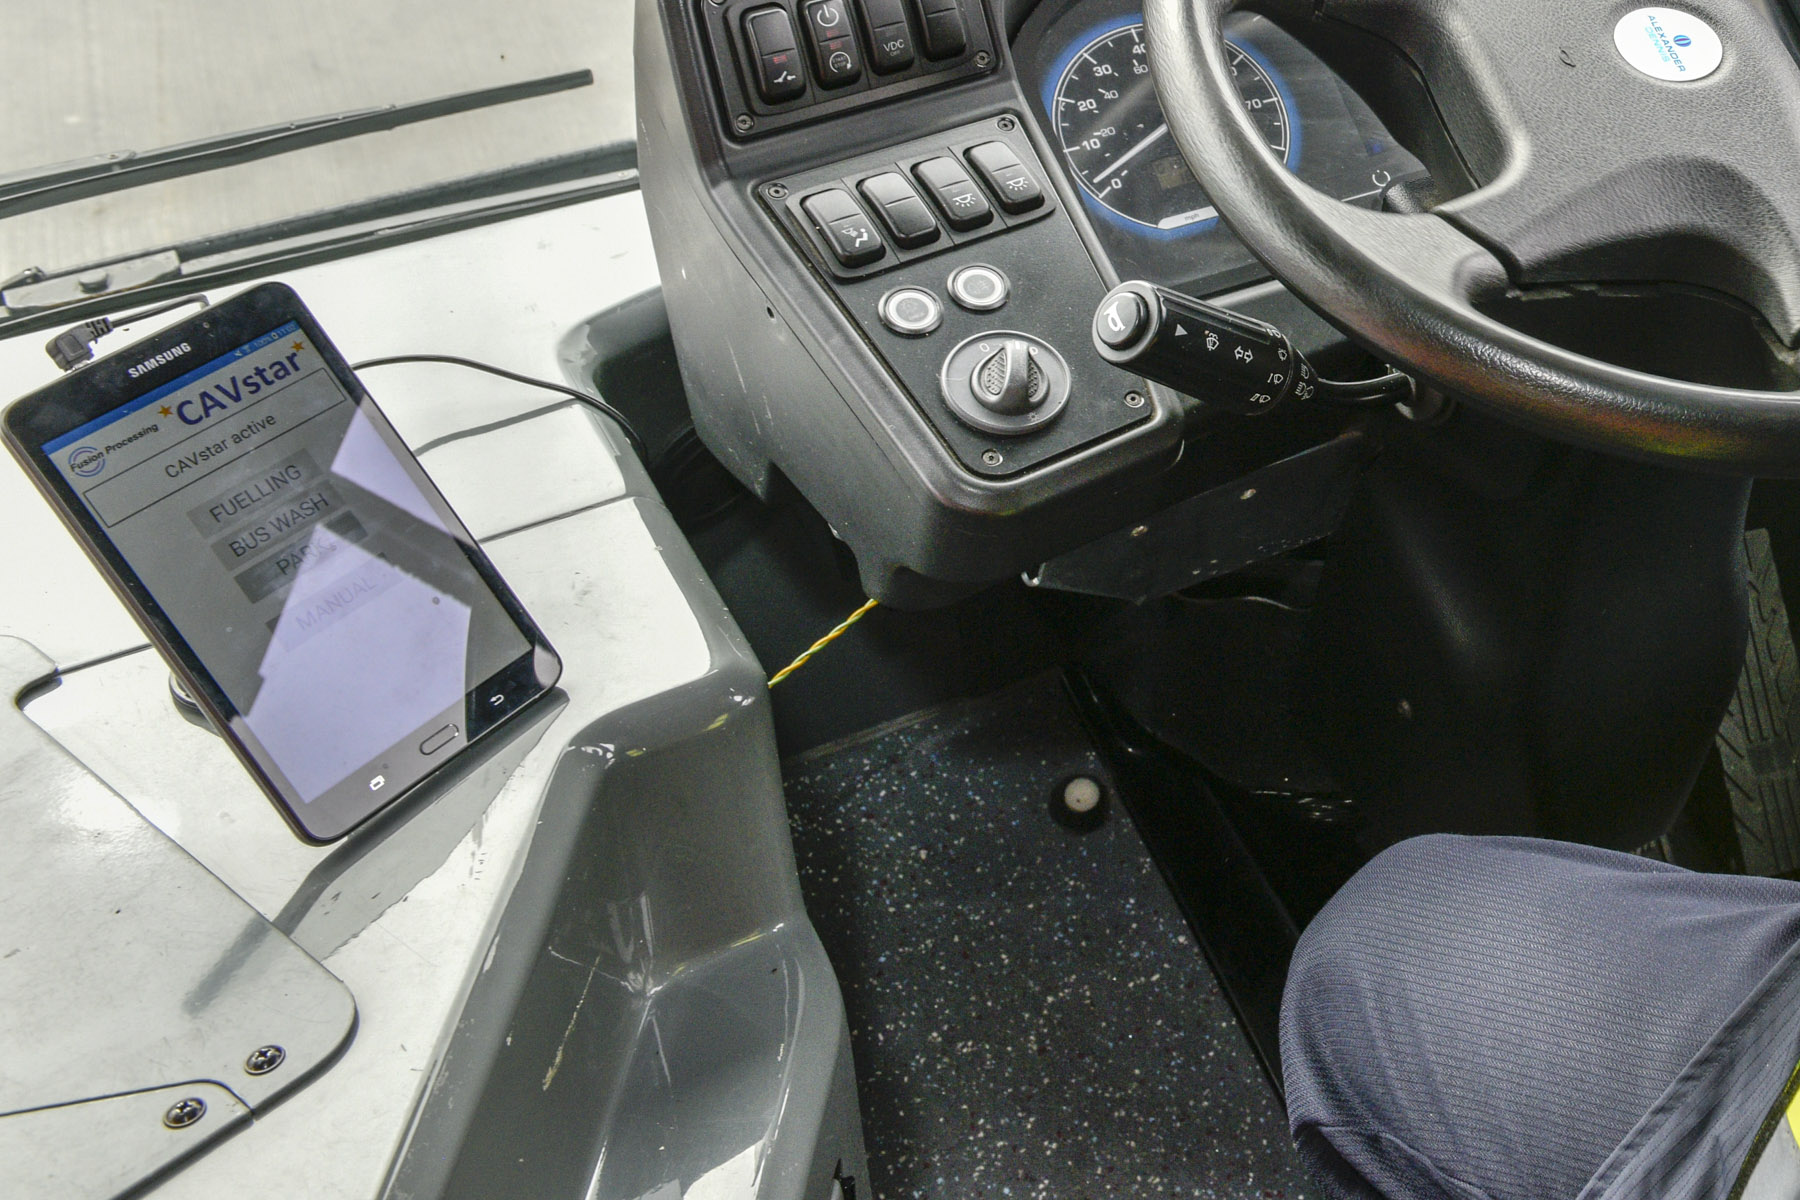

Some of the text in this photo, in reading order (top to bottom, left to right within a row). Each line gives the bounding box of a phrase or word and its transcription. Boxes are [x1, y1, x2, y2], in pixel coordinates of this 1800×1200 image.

[883, 39, 905, 53] VDC
[1648, 15, 1686, 72] ALEXANDER
[1093, 64, 1112, 76] 30
[1133, 64, 1148, 74] 60
[1103, 90, 1119, 99] 40
[1077, 99, 1097, 111] 20
[1246, 99, 1262, 109] 70
[1100, 127, 1116, 137] 20
[1081, 138, 1101, 150] 10
[1111, 178, 1122, 189] 0
[127, 342, 192, 378] SAMSUNG
[176, 351, 302, 426] CAVstar
[70, 423, 159, 472] Fusion Processing
[164, 413, 277, 479] CAVstar active
[209, 465, 302, 523] FUELLING
[229, 493, 329, 557] BUS WASH
[295, 576, 376, 630] MANUAL
